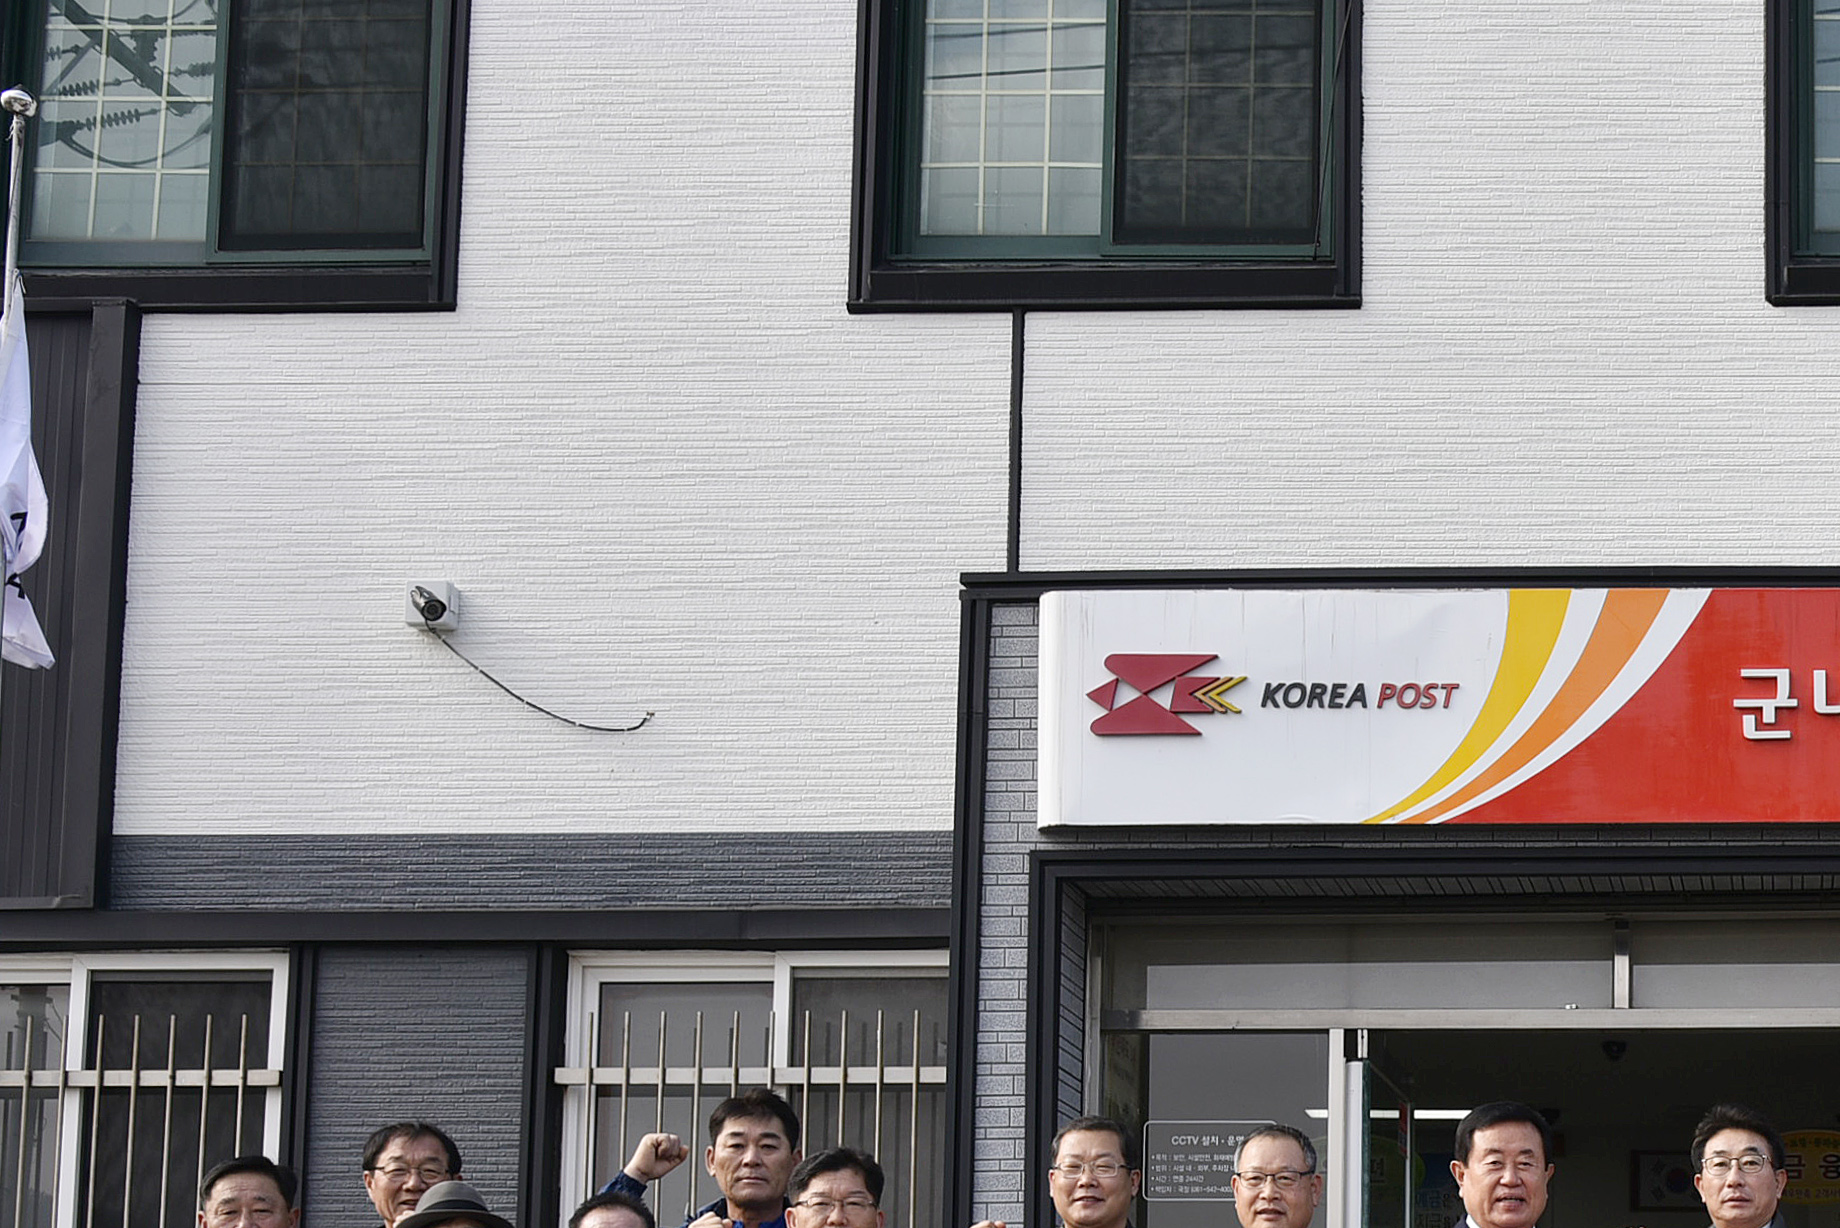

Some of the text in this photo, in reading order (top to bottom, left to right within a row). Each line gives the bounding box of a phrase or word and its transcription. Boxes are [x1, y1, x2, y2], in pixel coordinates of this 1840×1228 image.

[1261, 683, 1459, 710] KOREA POST
[1171, 1136, 1199, 1145] CCTV
